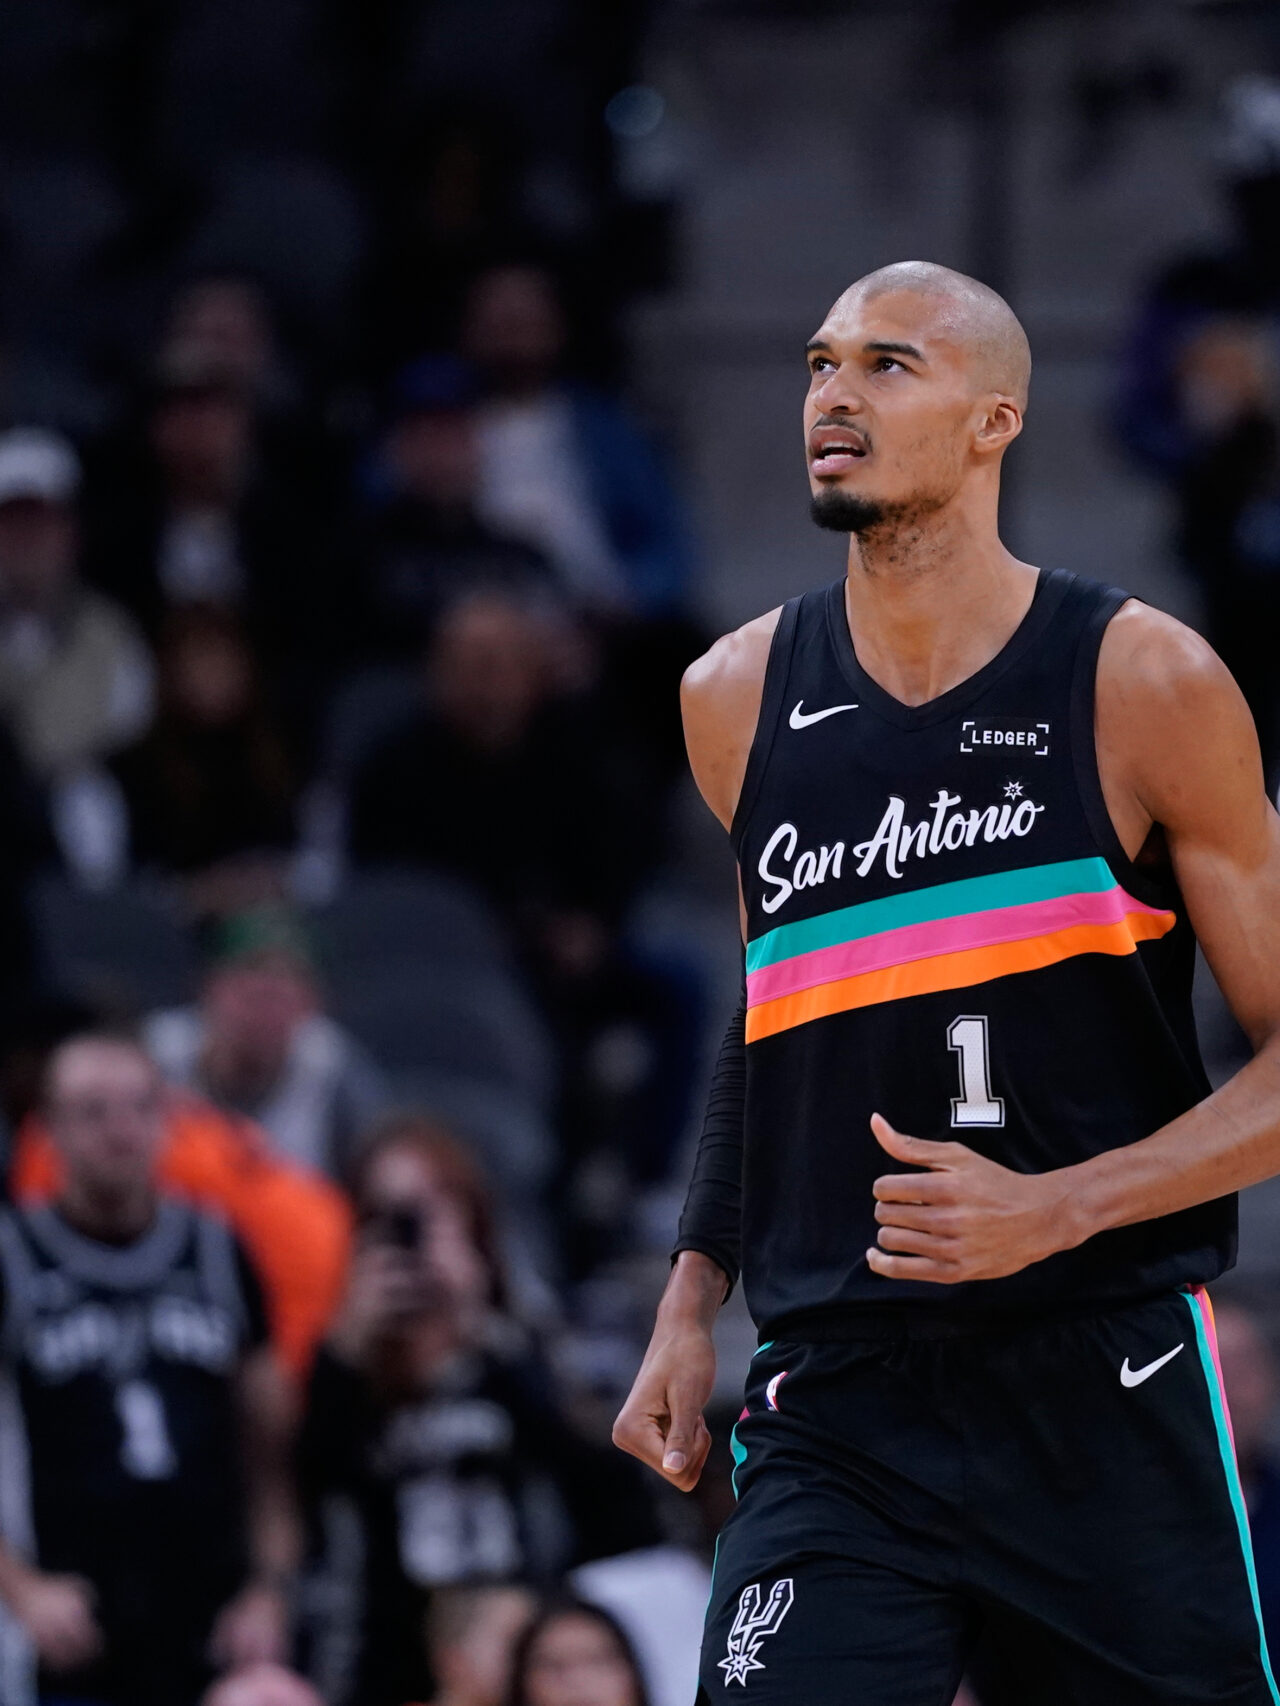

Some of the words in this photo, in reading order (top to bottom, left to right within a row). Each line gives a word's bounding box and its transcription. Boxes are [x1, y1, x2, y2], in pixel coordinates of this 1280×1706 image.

[971, 729, 1038, 747] LEDGER
[757, 819, 846, 915] San
[852, 782, 1047, 880] Antonio
[946, 1013, 1006, 1130] 1
